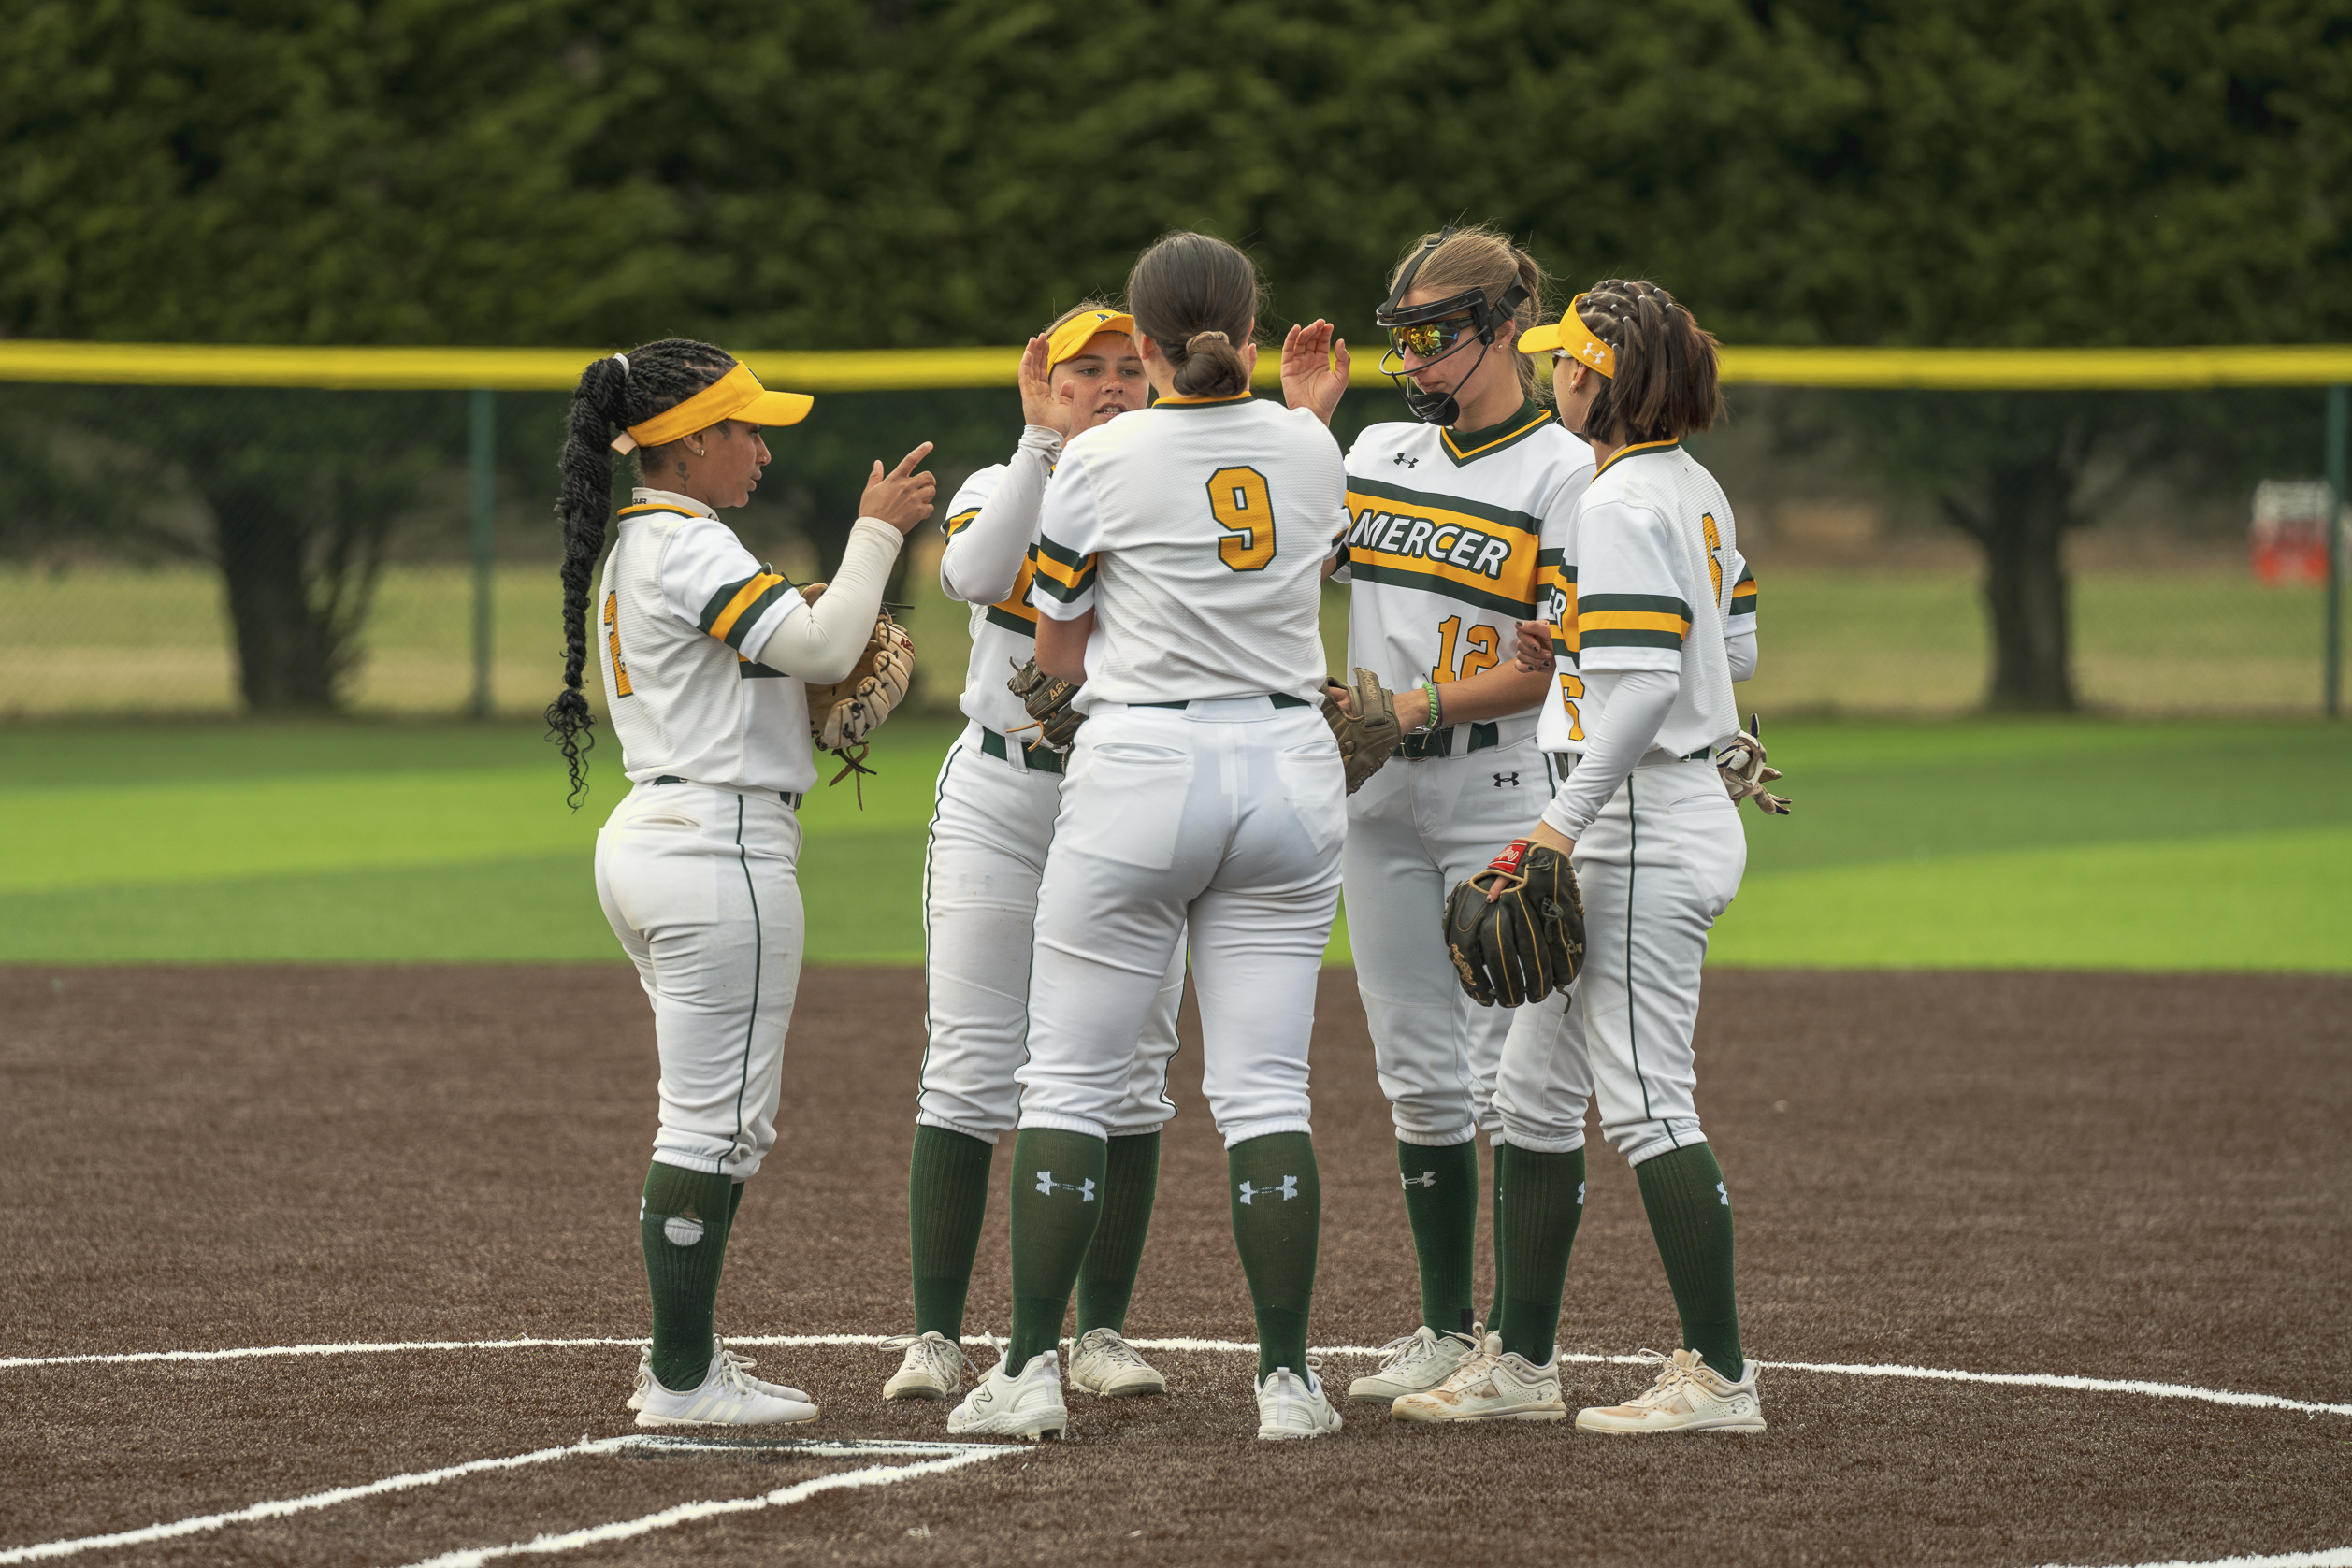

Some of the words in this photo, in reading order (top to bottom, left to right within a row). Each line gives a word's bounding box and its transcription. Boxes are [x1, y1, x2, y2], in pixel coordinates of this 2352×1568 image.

[1205, 465, 1277, 572] 9
[1349, 509, 1512, 581] MERCER
[1702, 511, 1723, 611] 6
[604, 589, 634, 699] 2
[1431, 614, 1500, 683] 12
